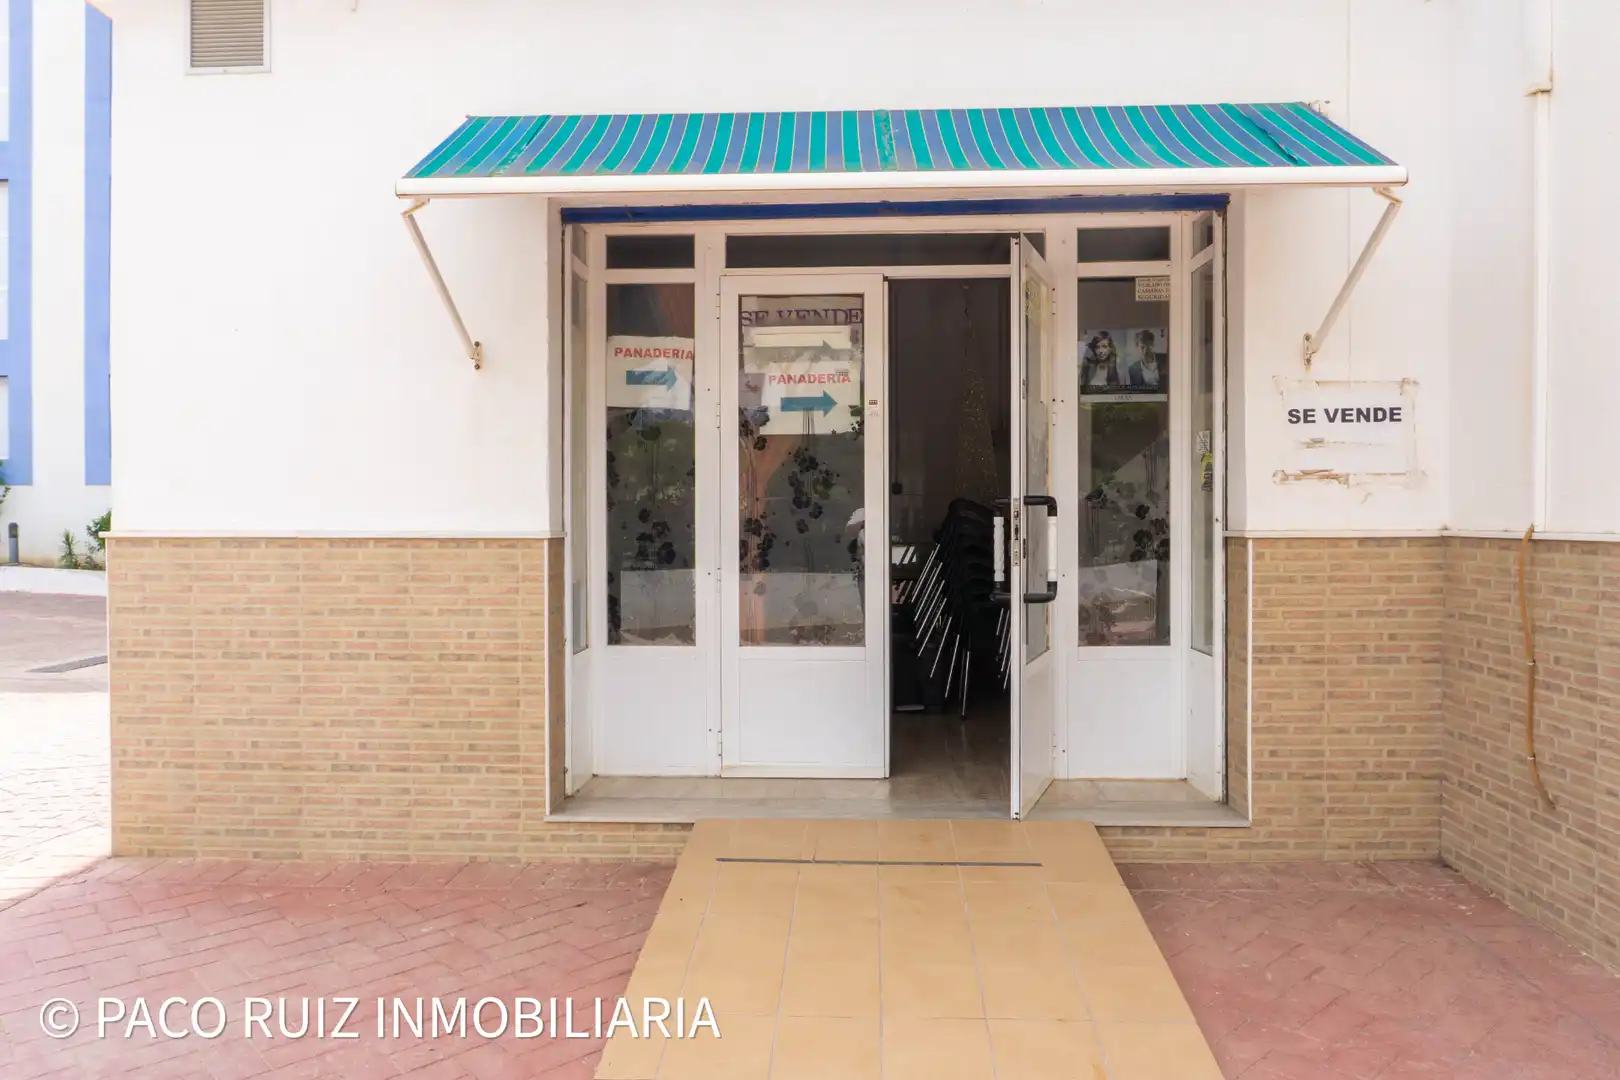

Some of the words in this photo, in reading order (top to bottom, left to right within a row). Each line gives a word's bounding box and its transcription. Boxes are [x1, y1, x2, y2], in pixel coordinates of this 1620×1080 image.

[614, 347, 693, 360] PANADERIA
[1288, 408, 1316, 424] SE
[1324, 407, 1402, 423] VENDE
